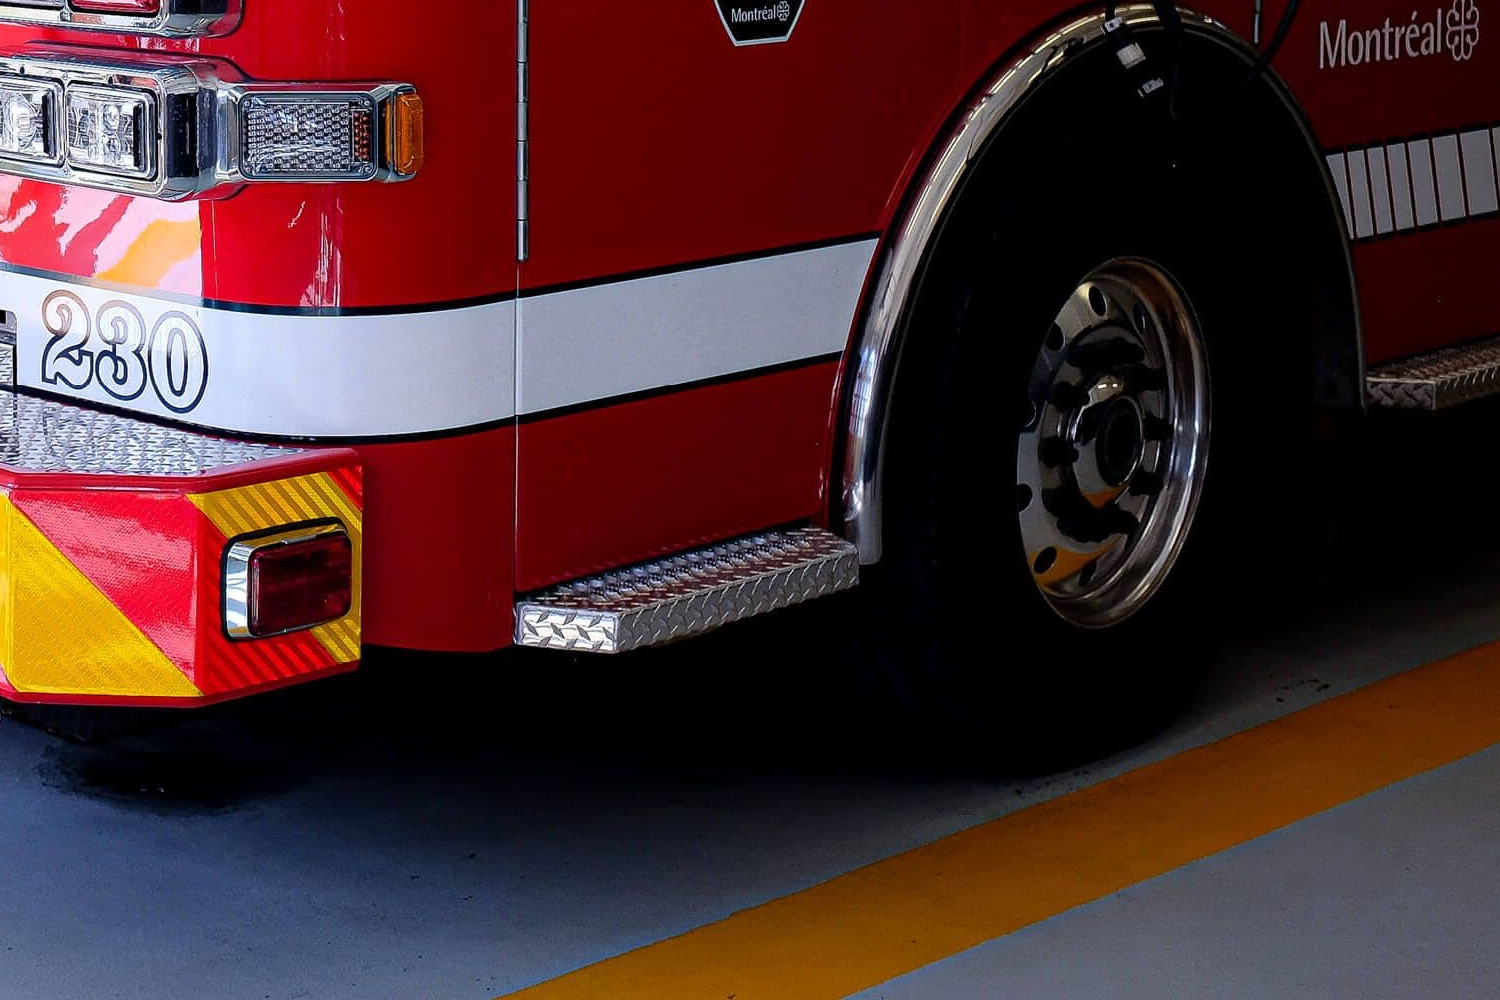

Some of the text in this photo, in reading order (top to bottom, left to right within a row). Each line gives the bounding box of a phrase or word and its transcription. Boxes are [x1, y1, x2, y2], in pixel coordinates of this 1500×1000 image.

[731, 4, 777, 23] Montréal
[1319, 7, 1443, 70] Montréal
[41, 289, 209, 414] 230
